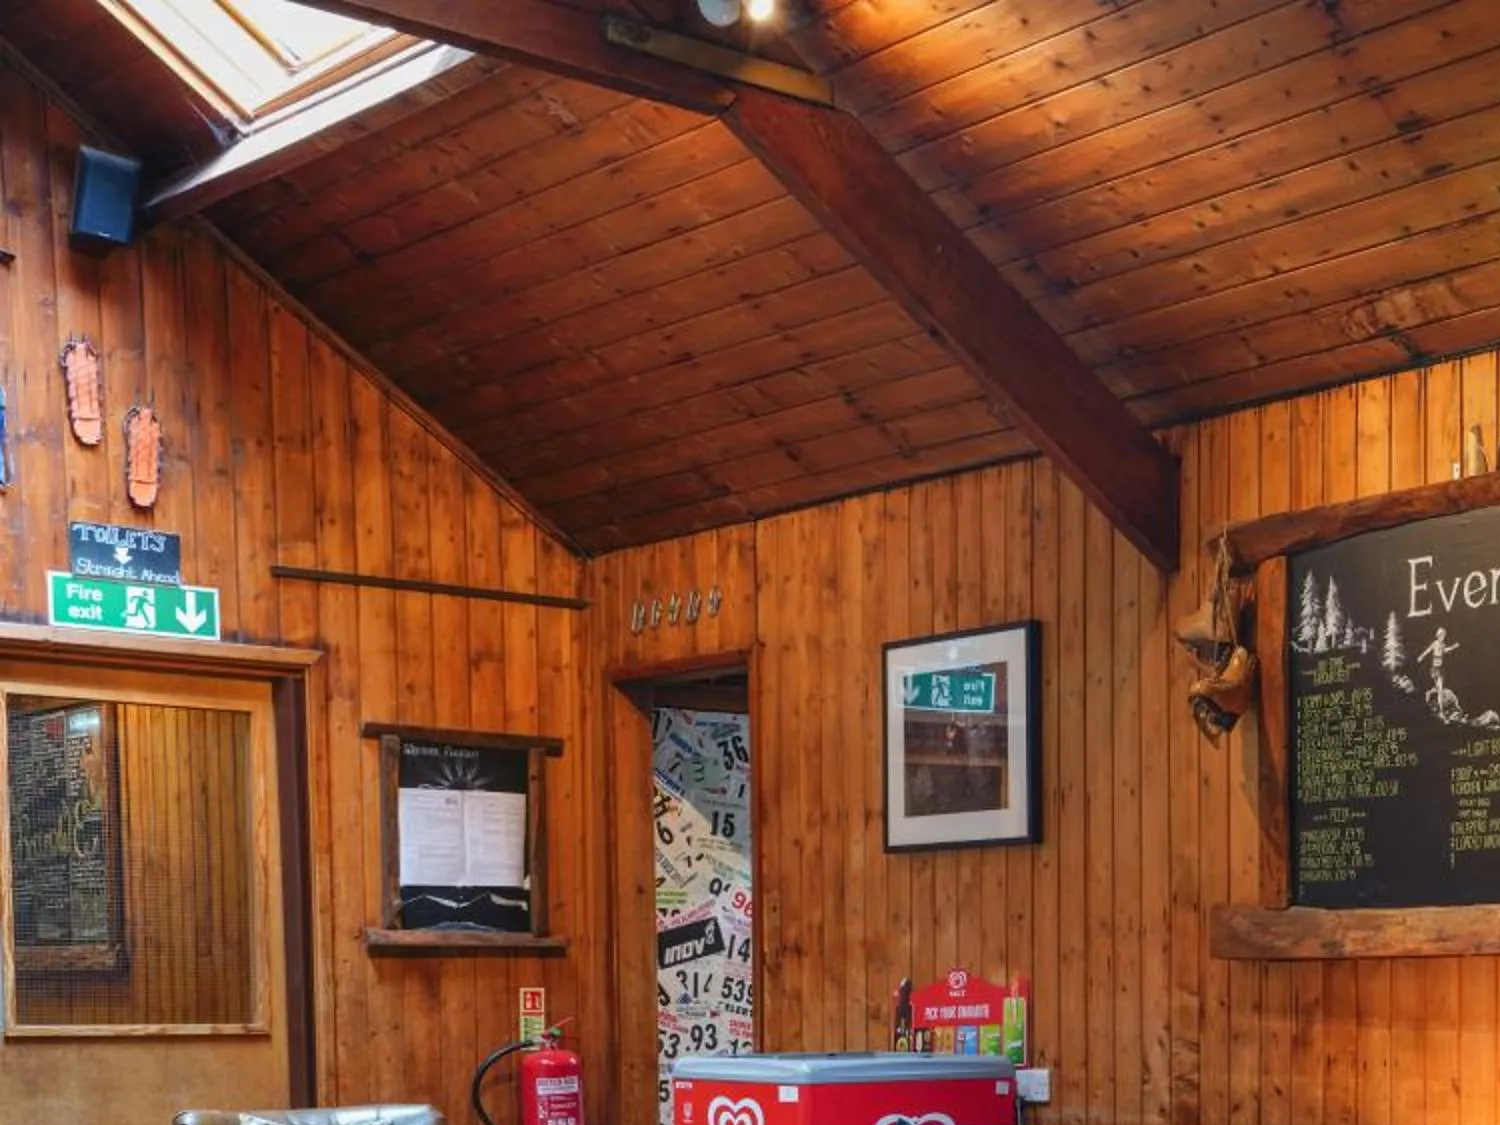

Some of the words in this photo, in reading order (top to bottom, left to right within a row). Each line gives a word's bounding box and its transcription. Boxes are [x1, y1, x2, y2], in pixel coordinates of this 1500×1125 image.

[71, 524, 167, 552] TOILETS
[66, 583, 104, 601] Fire
[67, 604, 103, 620] exit
[710, 811, 736, 838] 15
